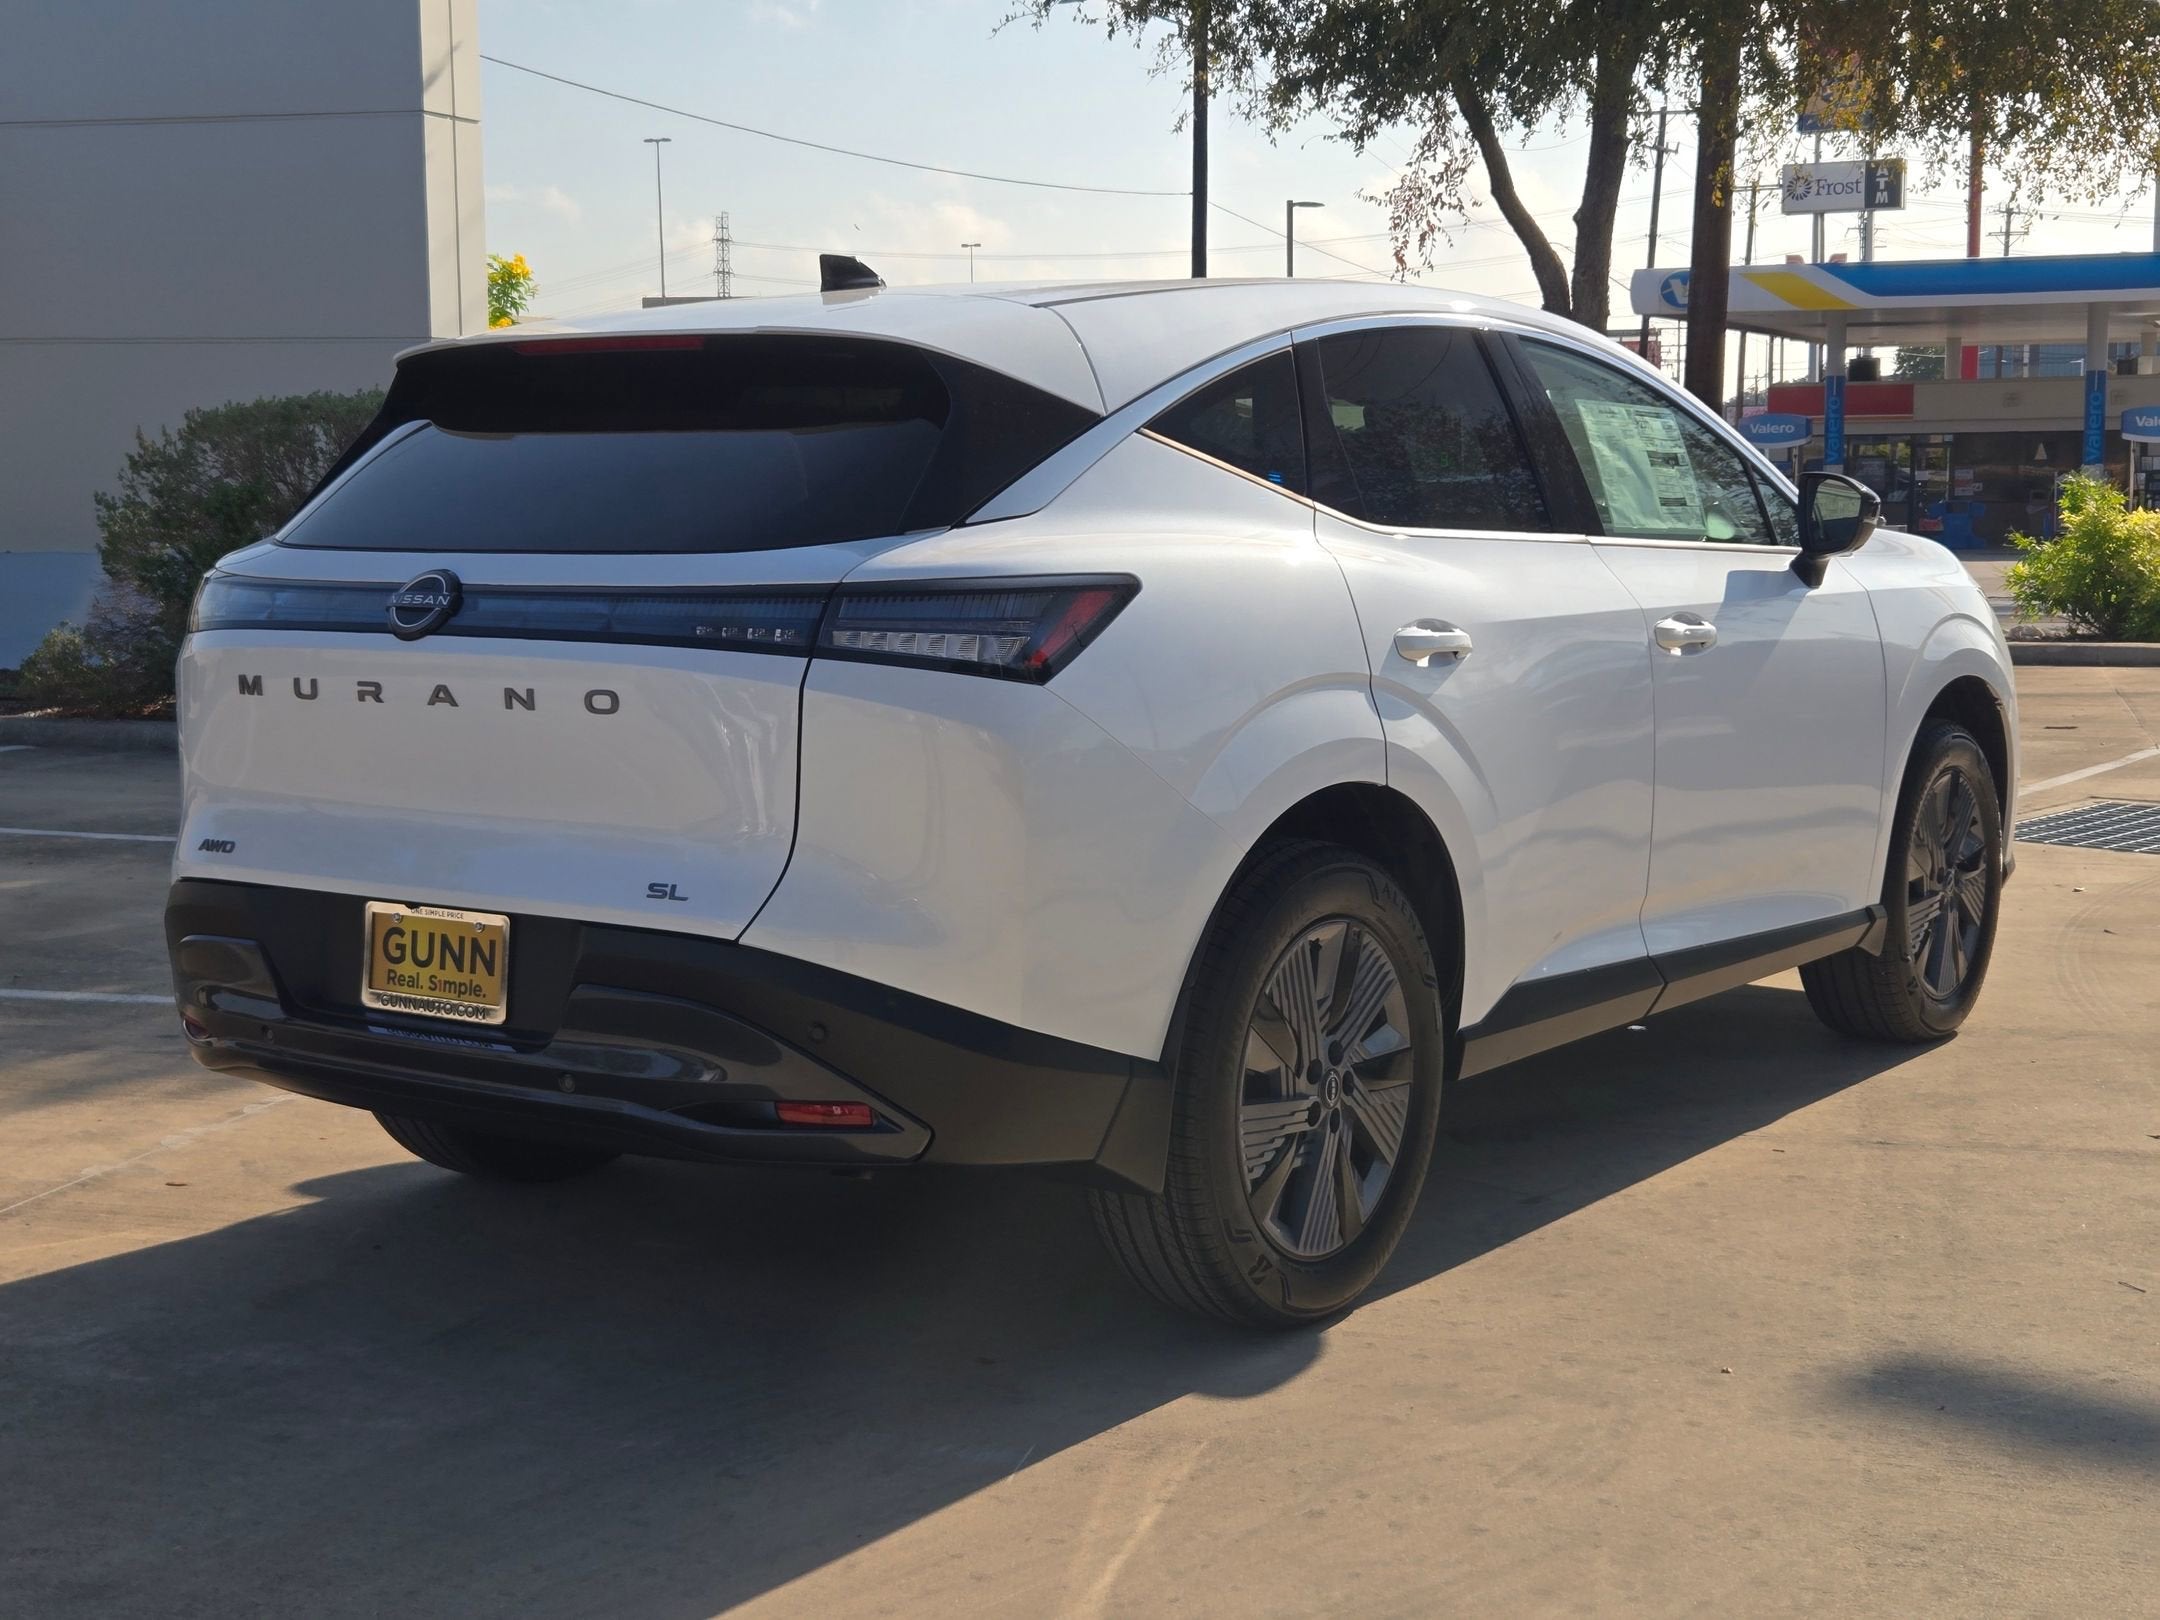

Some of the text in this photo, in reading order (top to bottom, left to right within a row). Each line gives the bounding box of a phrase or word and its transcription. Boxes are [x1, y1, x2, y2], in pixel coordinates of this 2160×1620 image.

[1814, 177, 1862, 196] Frost
[1875, 164, 1889, 204] ATM
[1750, 423, 1795, 434] Valero
[1826, 396, 1841, 464] Valero
[2085, 392, 2101, 464] Valero
[2135, 415, 2160, 427] Val
[392, 594, 450, 605] NISSAN
[237, 674, 621, 715] MURANO
[198, 838, 236, 853] AWD
[646, 883, 689, 901] SL
[382, 927, 497, 977] GUNN
[386, 969, 424, 989] Real.
[380, 994, 487, 1020] GUNNAUTO.COM
